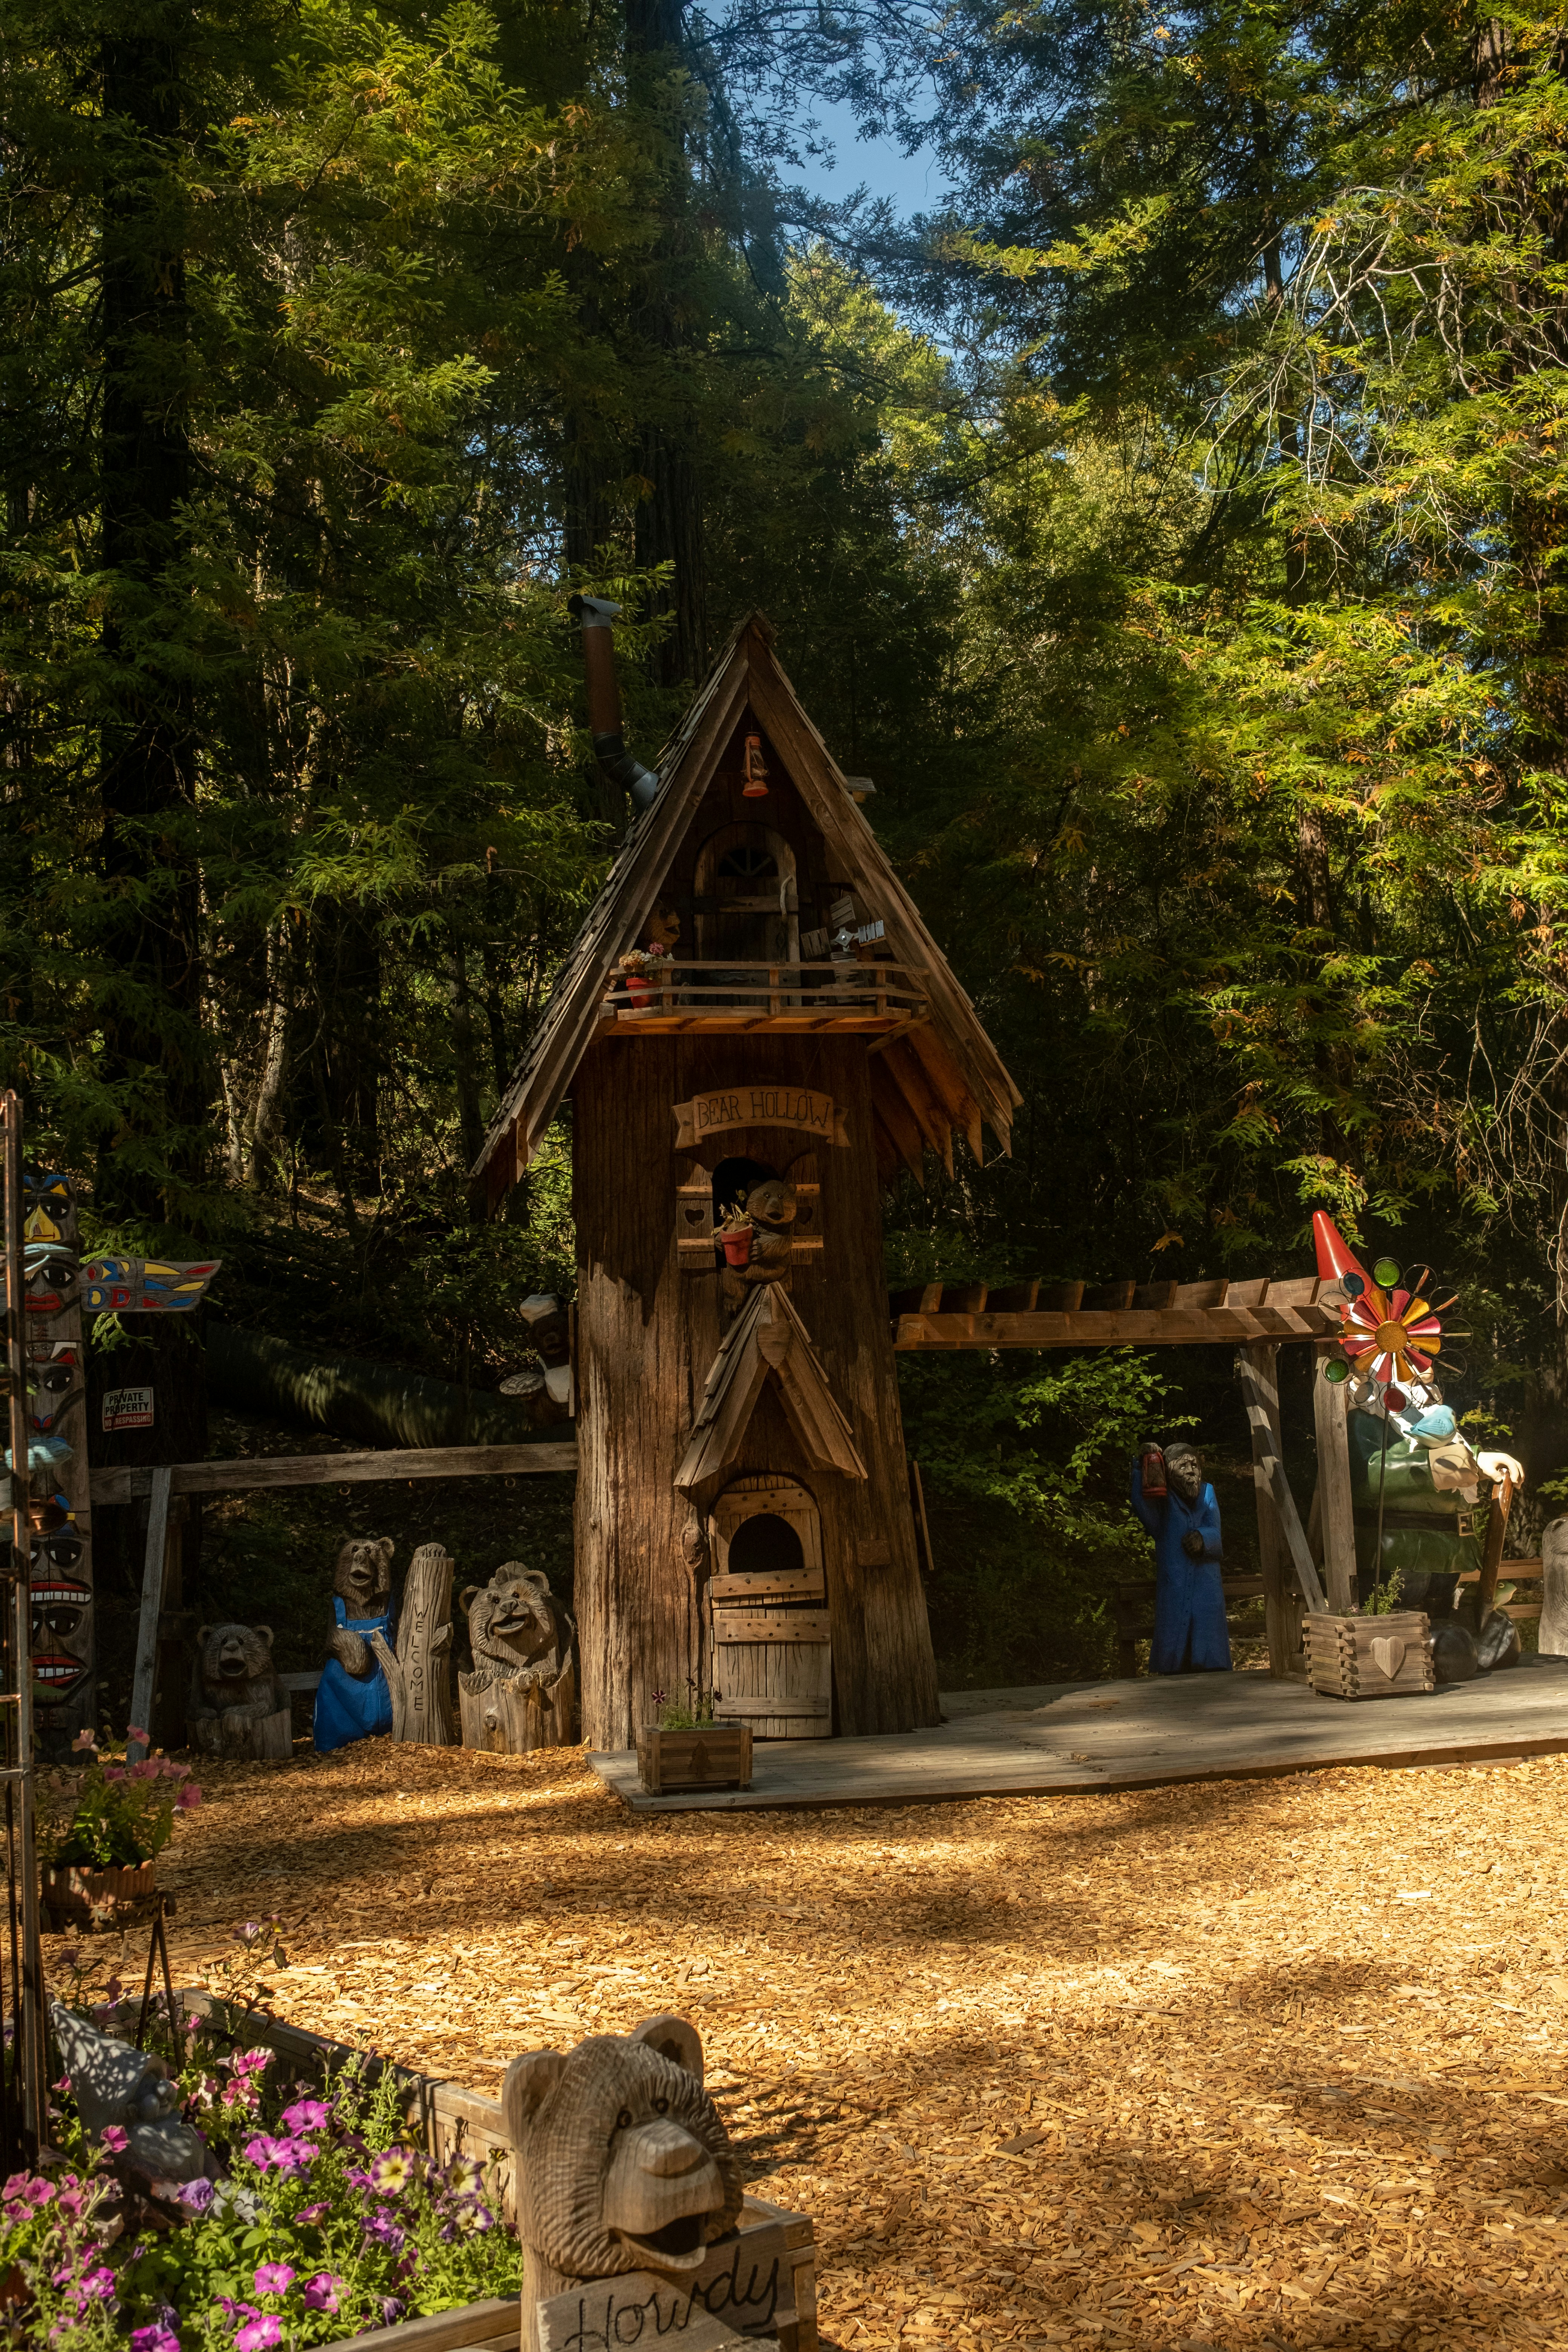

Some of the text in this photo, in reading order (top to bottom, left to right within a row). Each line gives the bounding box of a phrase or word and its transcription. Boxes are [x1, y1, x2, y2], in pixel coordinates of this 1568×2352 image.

[697, 1092, 831, 1129] BEAR HOLLOW
[105, 1402, 149, 1416] PROPERTY
[113, 1415, 151, 1425] RESPASSING
[410, 1603, 429, 1711] WELCOME
[564, 2245, 779, 2352] Howdy
